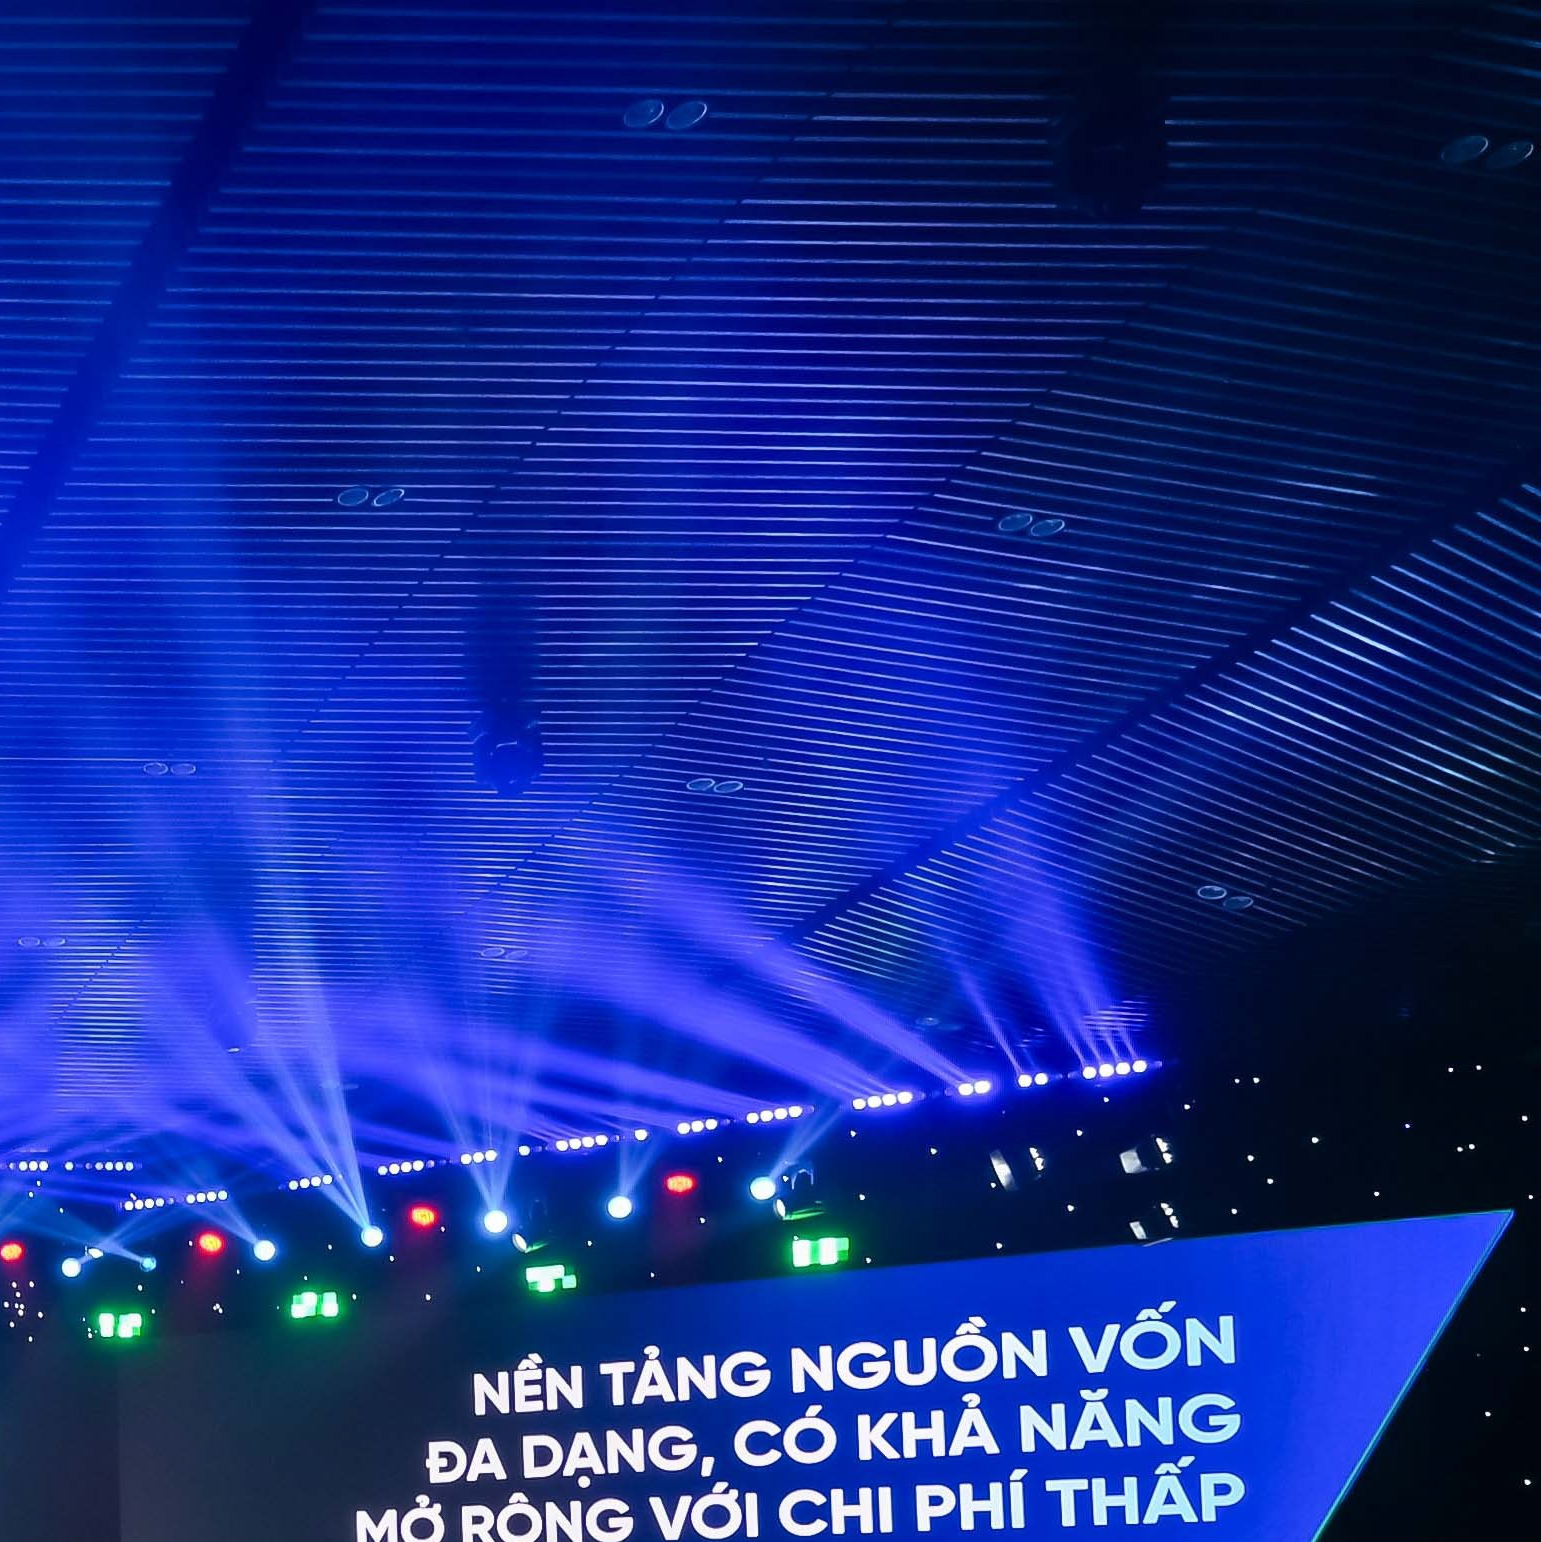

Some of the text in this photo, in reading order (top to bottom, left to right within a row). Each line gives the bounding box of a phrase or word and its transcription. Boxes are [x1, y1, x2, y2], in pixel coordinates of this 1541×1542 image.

[472, 1301, 1237, 1413] NỀN TẢNG NGUỒN VỐN
[427, 1390, 1241, 1485] ĐA DẠNG, CÓ KHẢ NĂNG
[650, 1487, 759, 1542] VỚI
[778, 1481, 894, 1537] CHI
[915, 1467, 1026, 1531] PHÍ
[1044, 1454, 1245, 1529] THẤP
